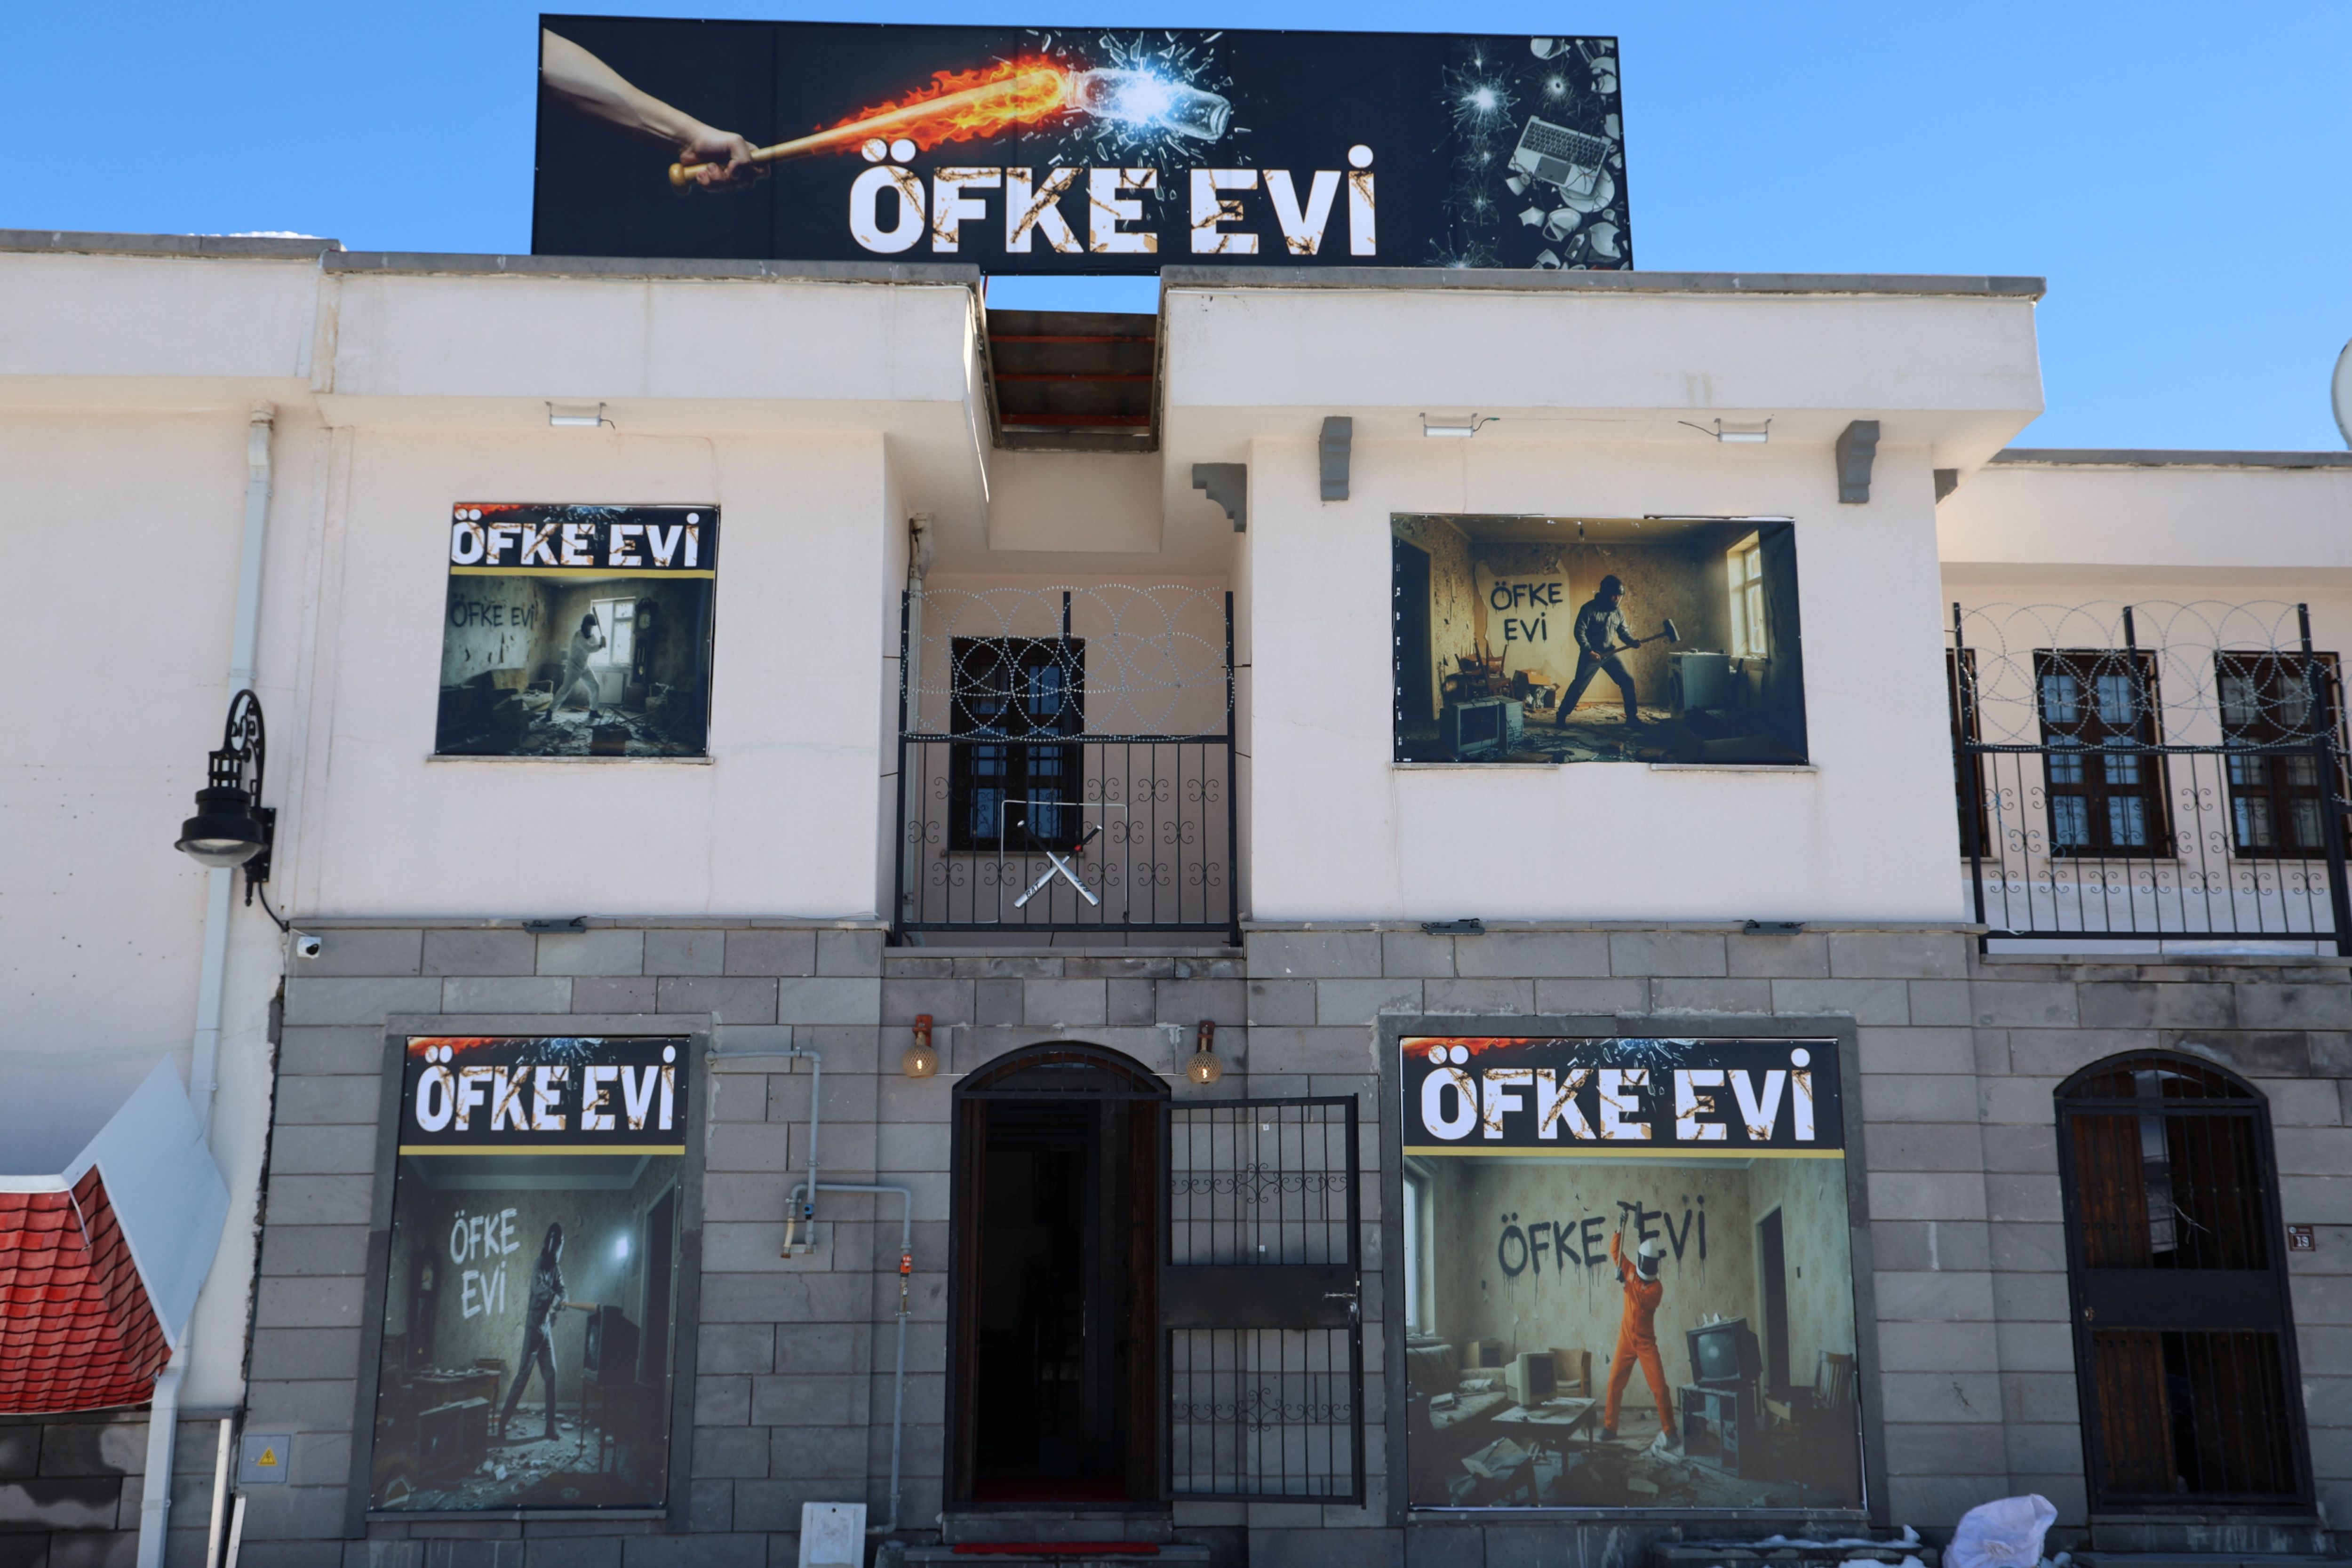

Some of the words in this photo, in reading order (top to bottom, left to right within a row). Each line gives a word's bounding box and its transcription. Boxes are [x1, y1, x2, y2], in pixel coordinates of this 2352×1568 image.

[849, 138, 1158, 254] ÖFKE
[1190, 144, 1376, 256] EVİ
[451, 508, 594, 565] ÖFKE
[608, 512, 700, 567] EVİ
[451, 596, 503, 628] ÖFKE
[1490, 581, 1563, 611] ÖFKE
[1504, 612, 1547, 642] EVİ
[1026, 882, 1039, 898] BAT
[415, 1045, 569, 1132] ÖFKE
[581, 1045, 676, 1131] EVİ
[1421, 1045, 1651, 1140] ÖFKE
[1674, 1048, 1815, 1141] EVİ
[449, 1208, 520, 1265] ÖFKE
[1498, 1212, 1608, 1278] ÖFKE
[2296, 1236, 2309, 1247] 19
[461, 1261, 507, 1319] EVİ
